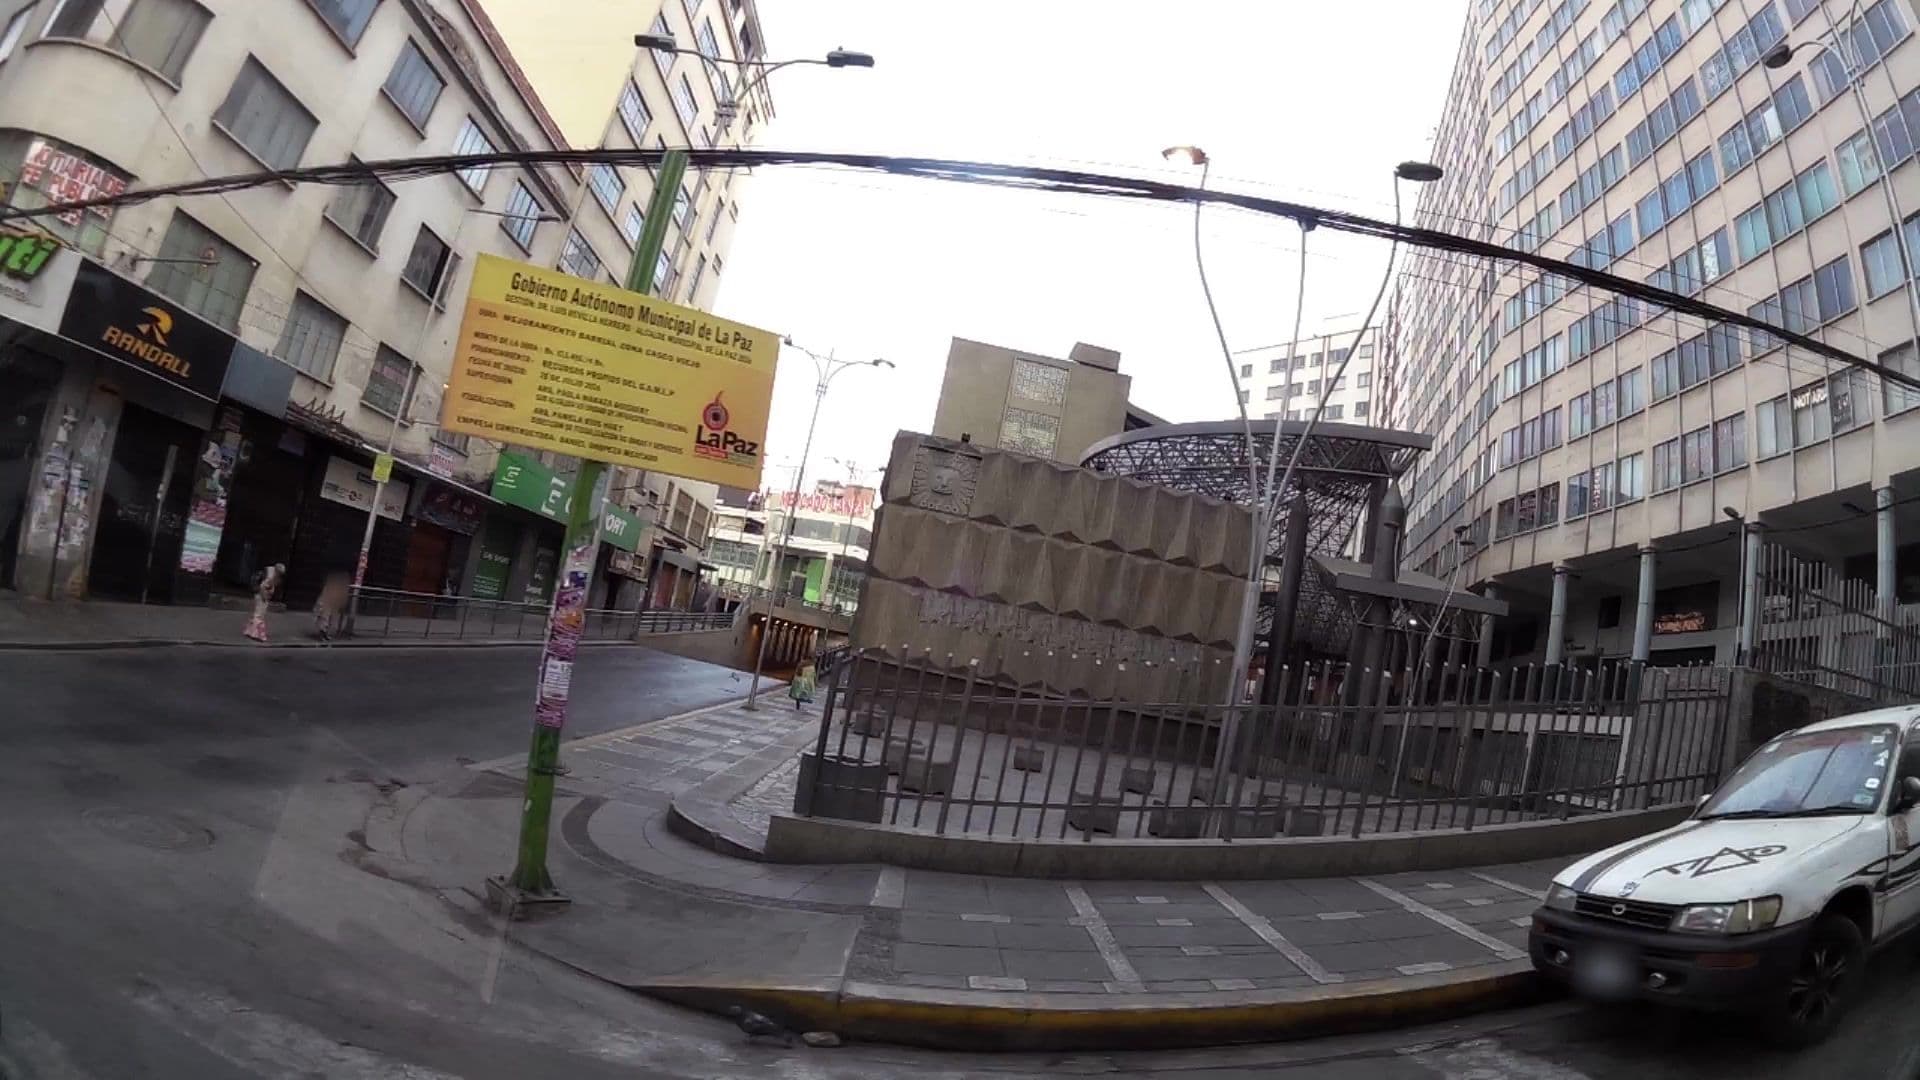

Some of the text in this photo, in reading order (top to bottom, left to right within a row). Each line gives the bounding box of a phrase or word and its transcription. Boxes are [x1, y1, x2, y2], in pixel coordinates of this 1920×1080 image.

[510, 271, 753, 352] Gobierno Autónomo Municipal de La Paz
[102, 325, 190, 378] RANDALL
